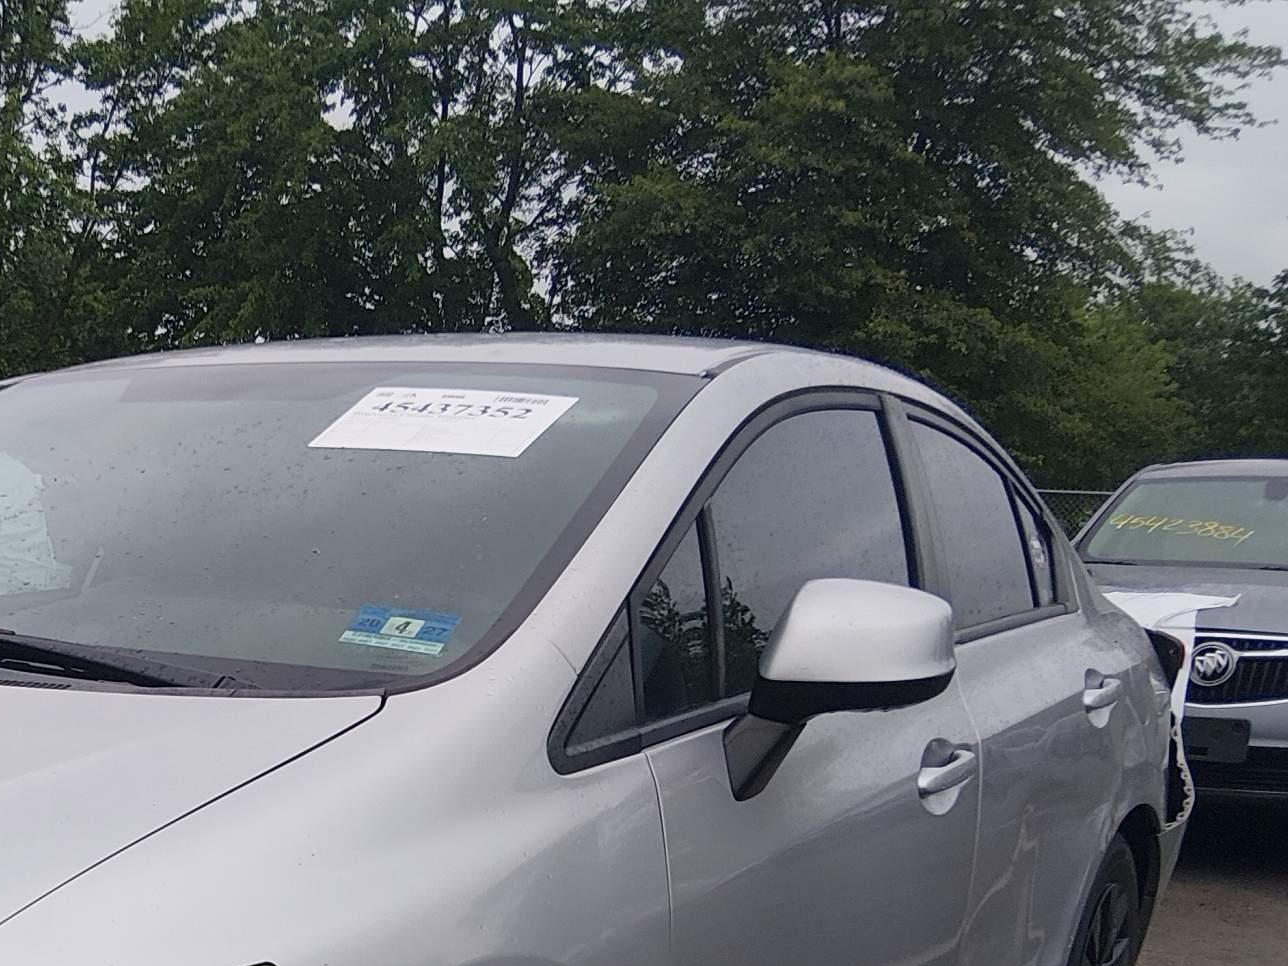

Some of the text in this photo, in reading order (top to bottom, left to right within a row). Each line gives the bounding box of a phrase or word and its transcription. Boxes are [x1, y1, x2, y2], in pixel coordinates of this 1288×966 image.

[371, 401, 533, 419] 45437352
[1110, 514, 1255, 547] 45423884
[395, 621, 412, 634] 4
